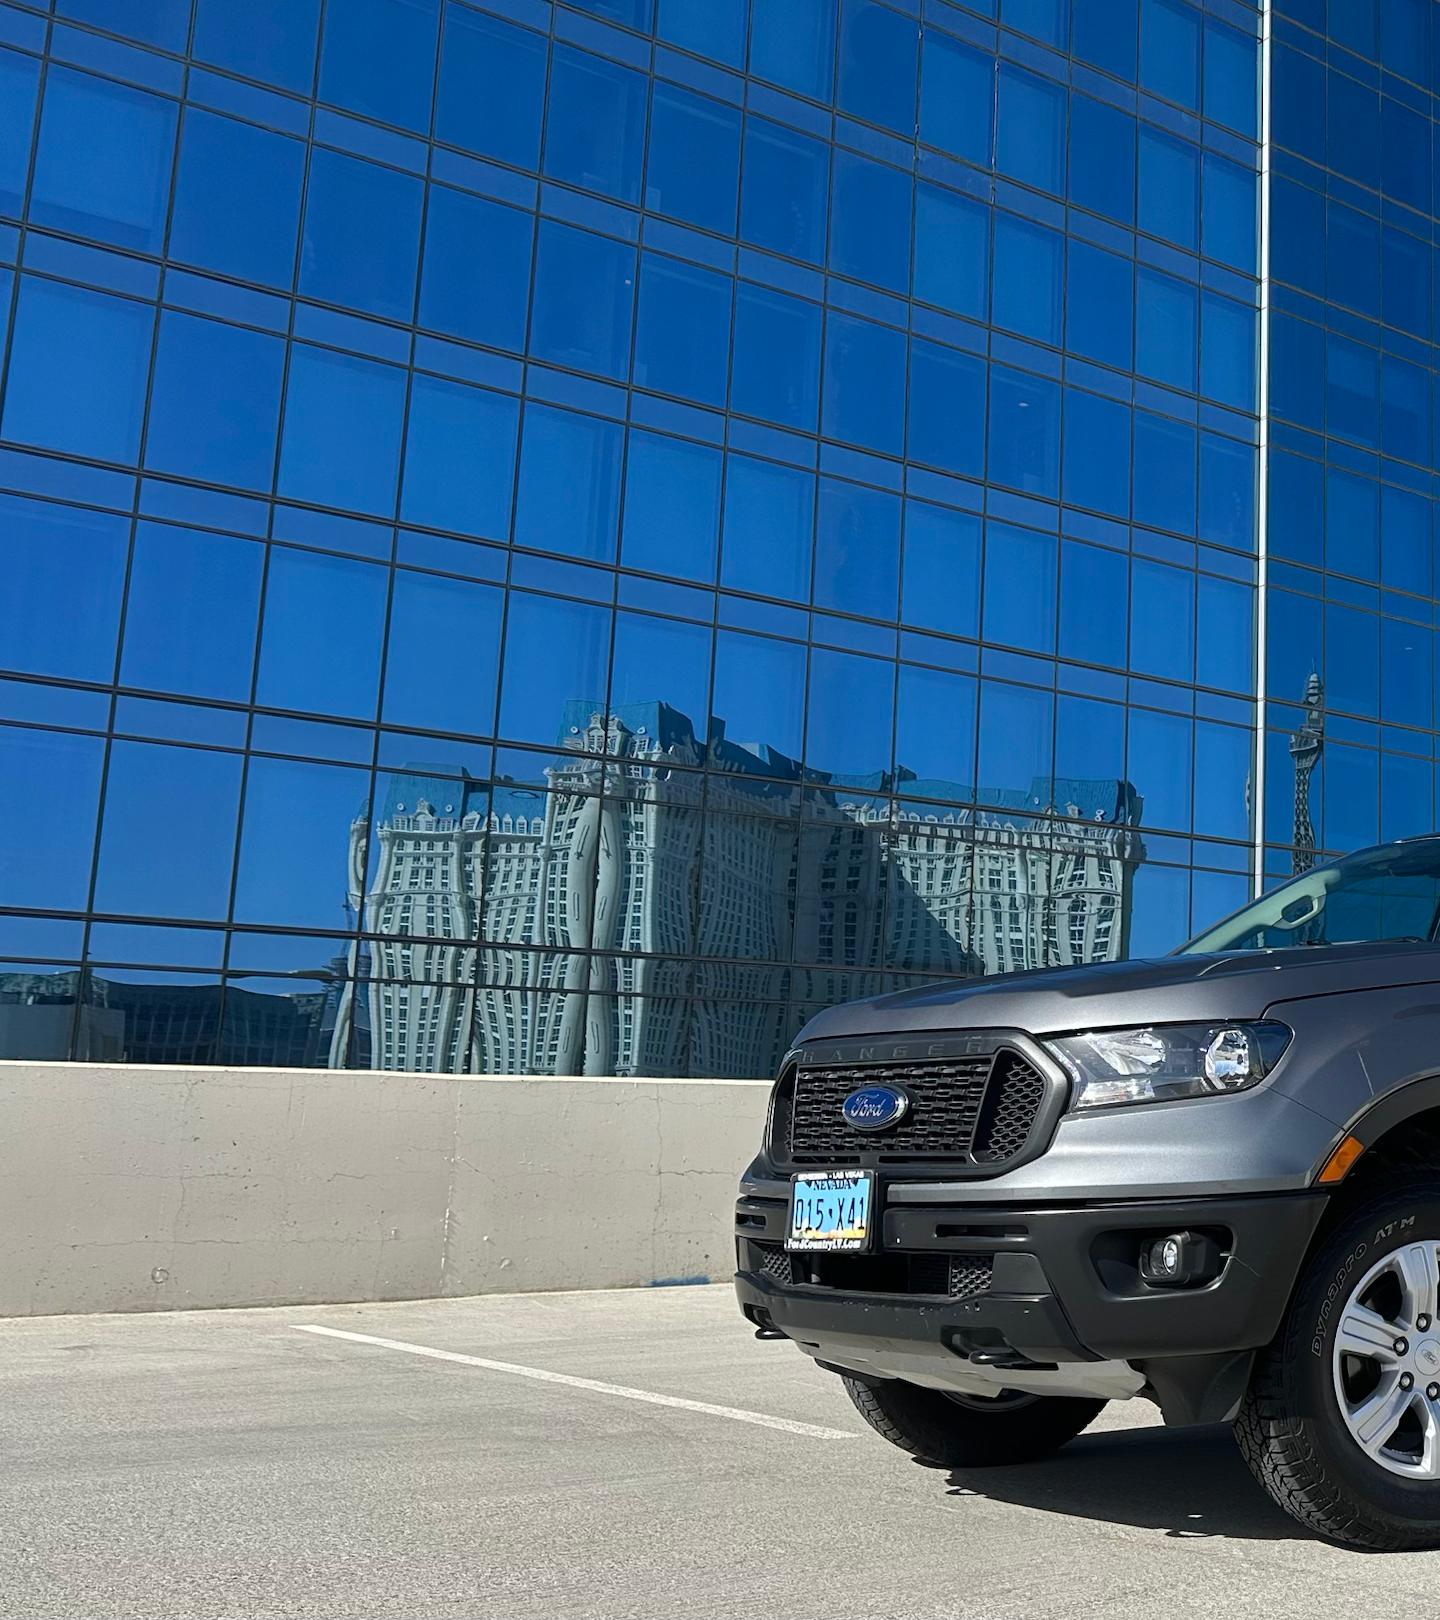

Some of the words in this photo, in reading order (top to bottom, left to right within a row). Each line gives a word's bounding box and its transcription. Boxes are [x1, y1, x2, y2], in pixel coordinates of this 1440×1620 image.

[802, 1036, 983, 1063] RANGER
[850, 1093, 887, 1117] Ford
[813, 1180, 852, 1191] NEVADA
